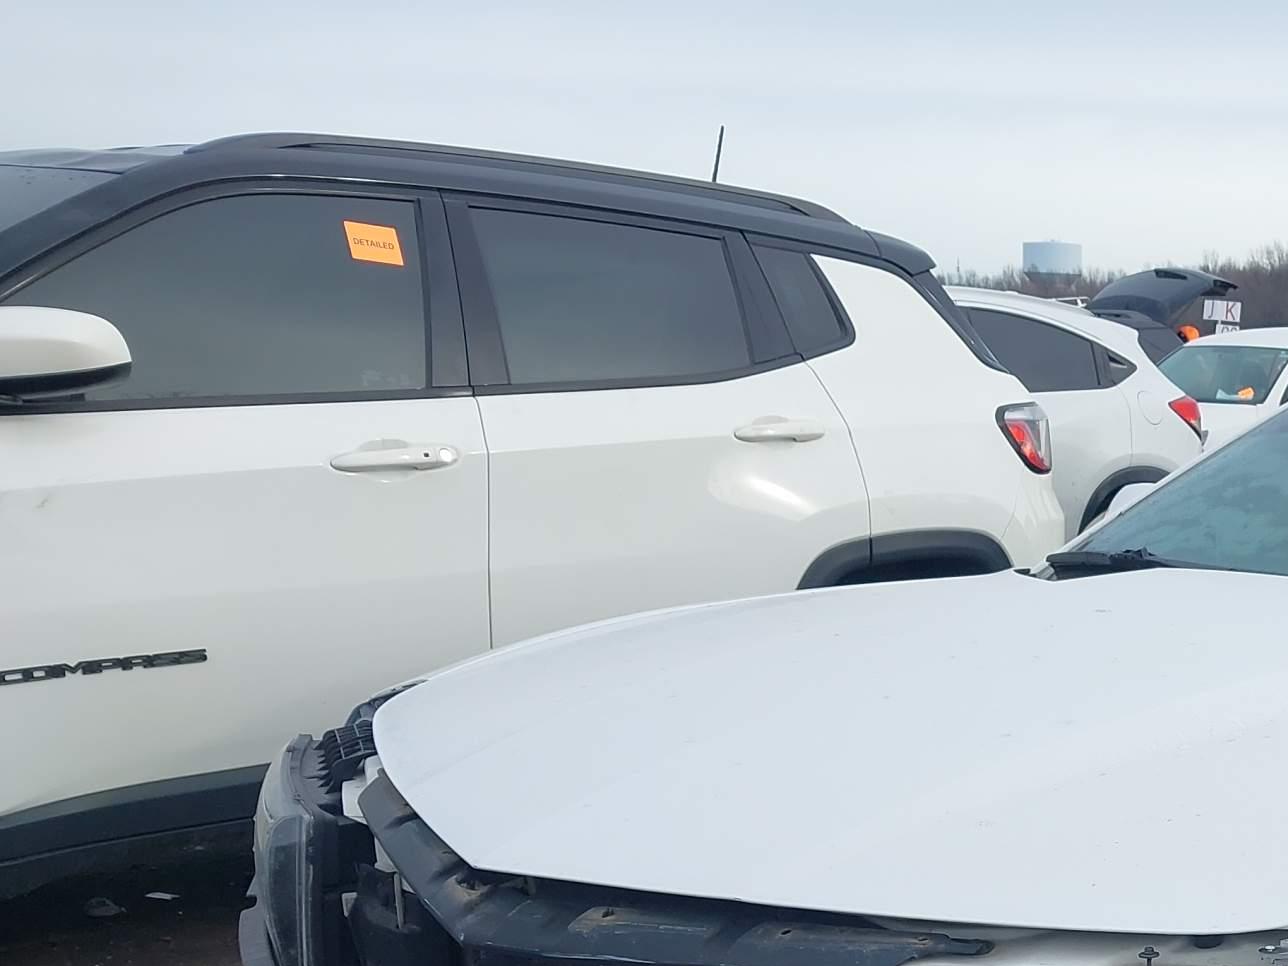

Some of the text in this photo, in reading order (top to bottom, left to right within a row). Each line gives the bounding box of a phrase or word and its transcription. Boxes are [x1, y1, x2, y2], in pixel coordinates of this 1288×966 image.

[353, 237, 394, 250] DETAILED
[1207, 300, 1236, 320] J K
